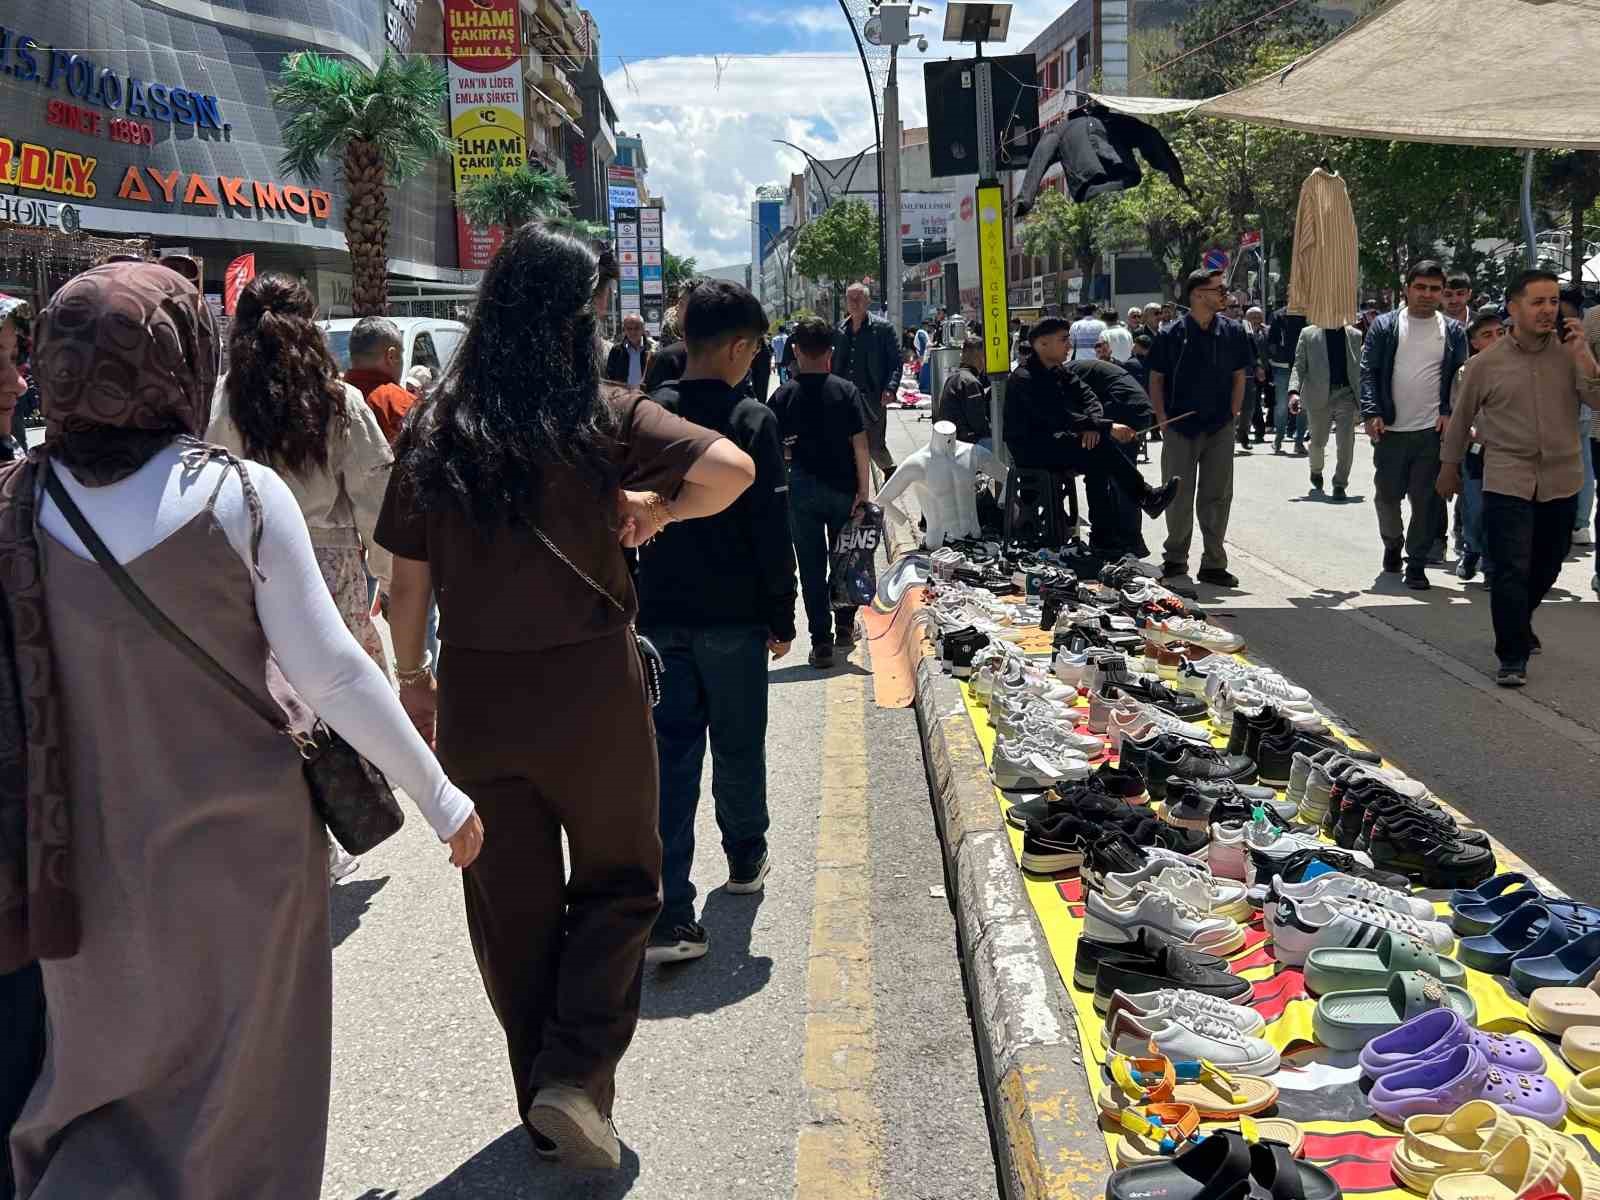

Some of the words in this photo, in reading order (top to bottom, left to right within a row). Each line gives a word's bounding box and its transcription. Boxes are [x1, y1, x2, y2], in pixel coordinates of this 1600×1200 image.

[449, 9, 514, 27] İLHAMİ
[451, 29, 514, 44] ÇAKIRTAŞ
[452, 46, 492, 58] EMLAK
[48, 46, 122, 111] POLO
[455, 92, 485, 105] EMLAK
[47, 98, 102, 133] SINCE
[110, 117, 154, 146] 1890
[457, 136, 521, 155] İLHAMİ
